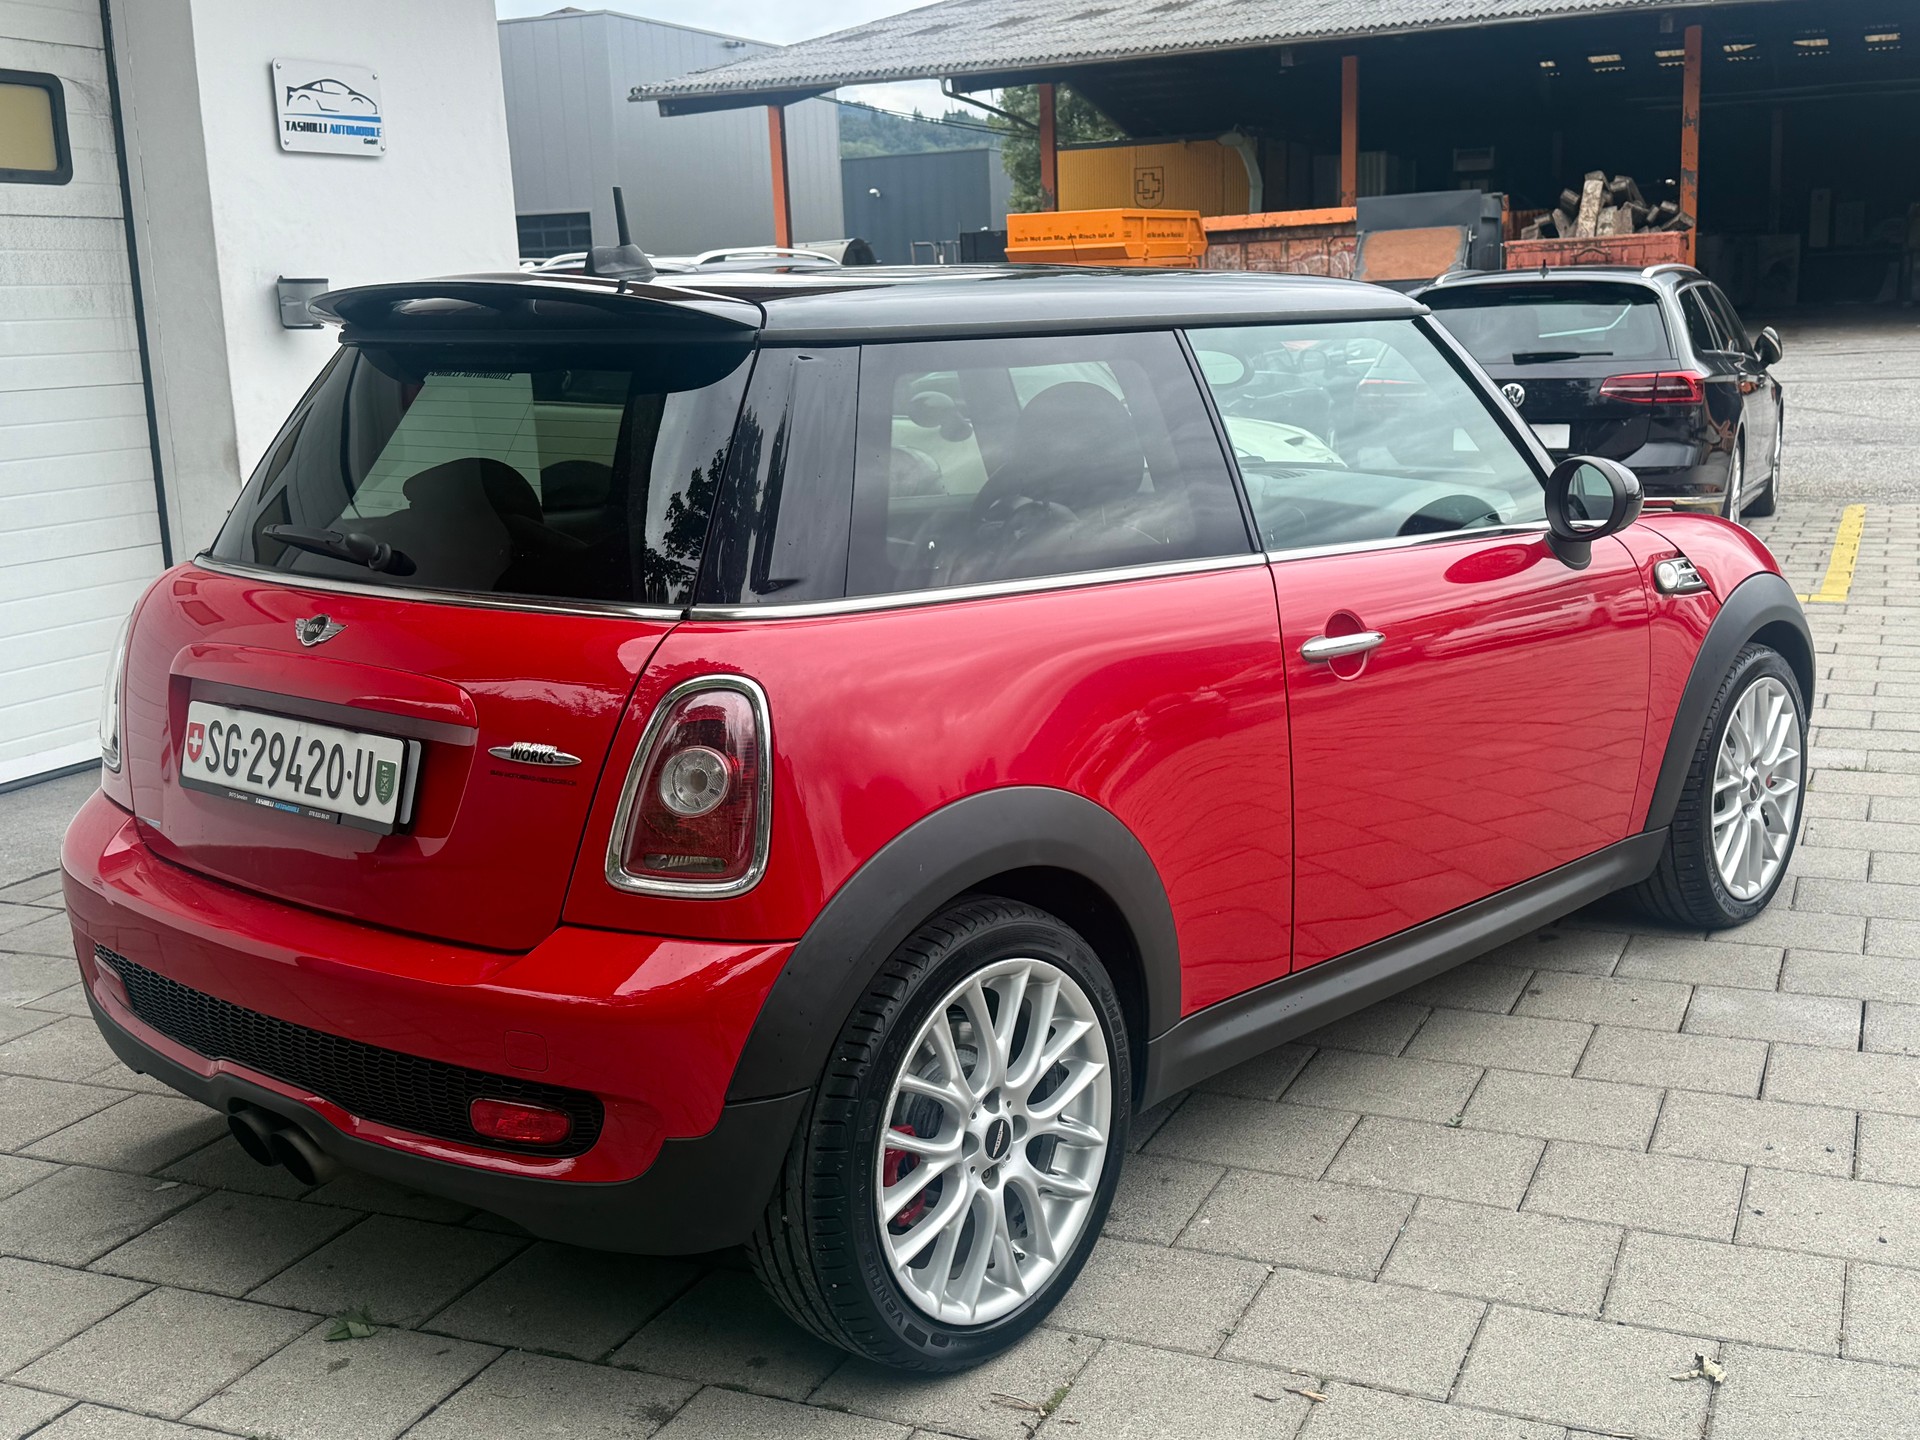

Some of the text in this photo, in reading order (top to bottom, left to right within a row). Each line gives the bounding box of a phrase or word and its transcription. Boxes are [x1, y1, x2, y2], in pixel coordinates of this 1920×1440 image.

[285, 120, 382, 138] TASHOLLI AUTOMOBILE
[306, 623, 323, 633] MINI
[510, 748, 555, 764] WORKS
